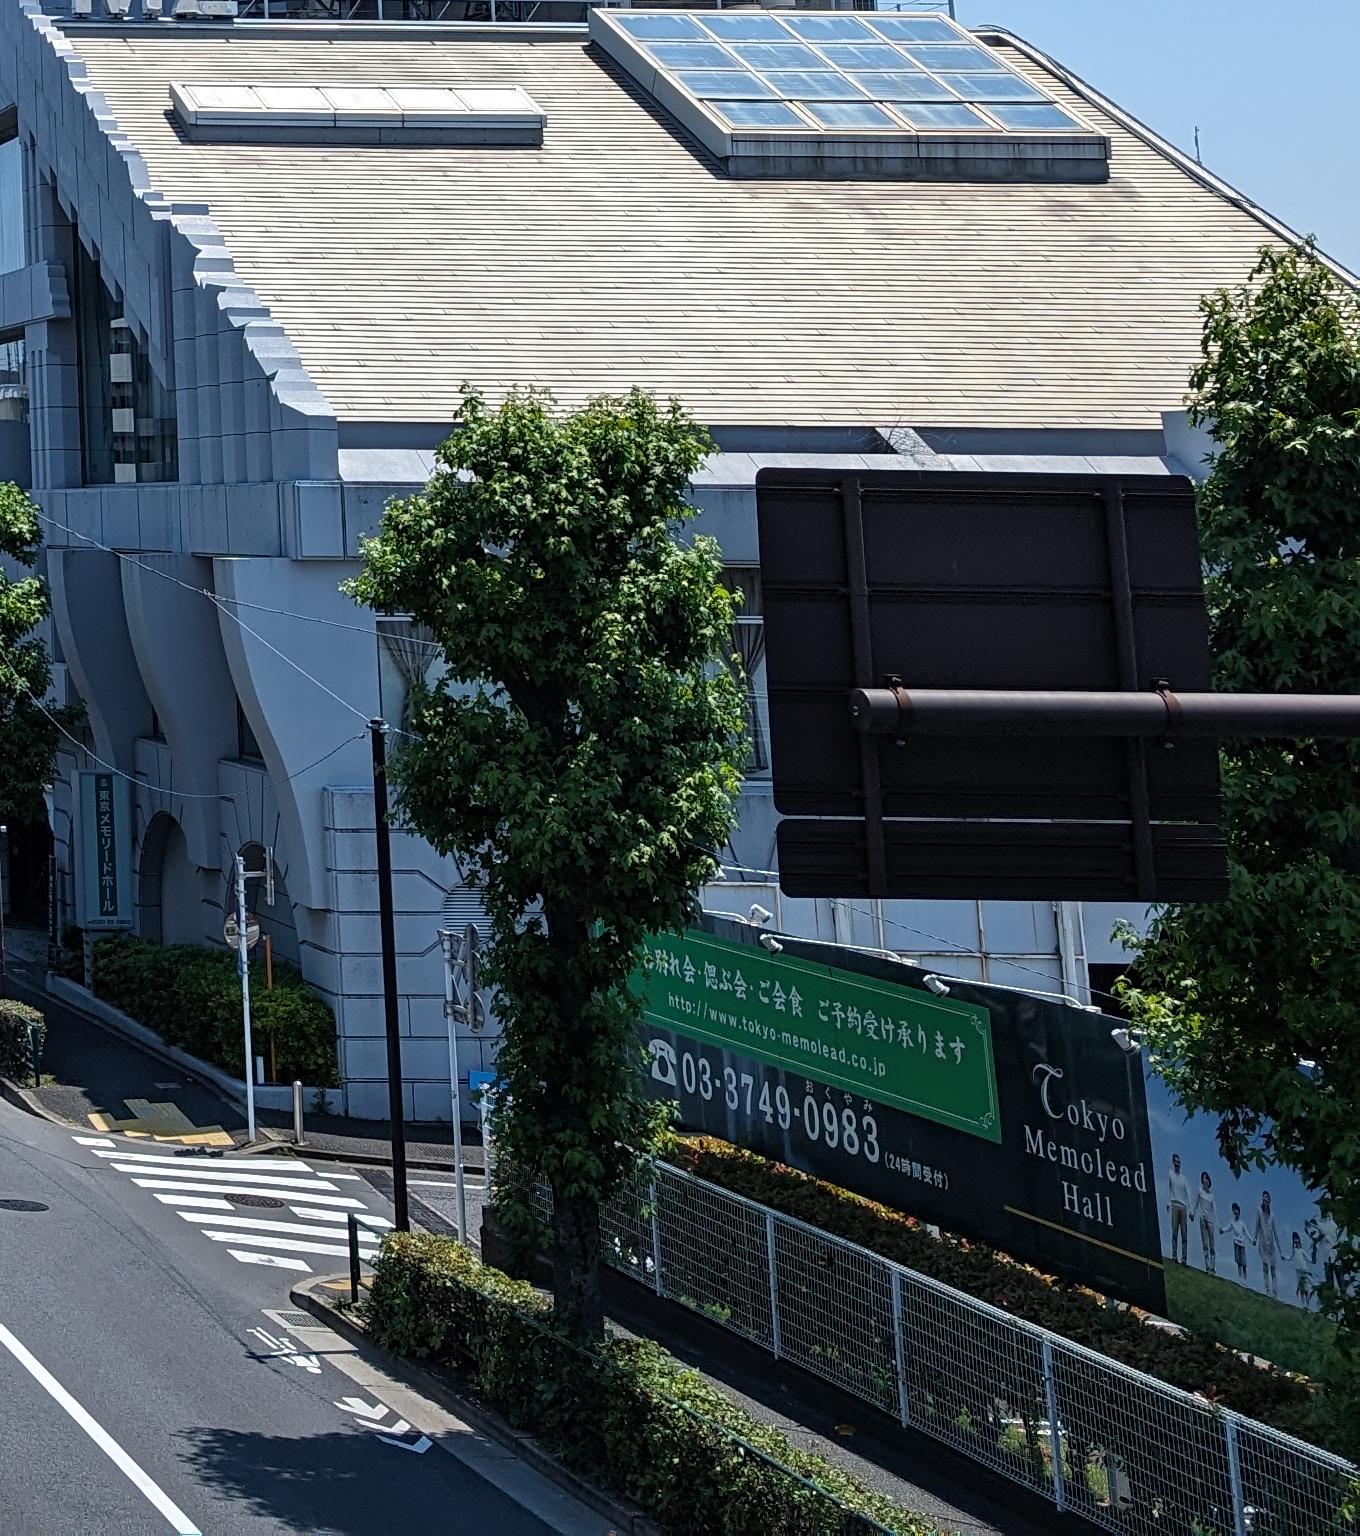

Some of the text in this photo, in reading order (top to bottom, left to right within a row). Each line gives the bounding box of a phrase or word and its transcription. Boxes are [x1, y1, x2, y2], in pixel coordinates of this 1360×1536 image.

[98, 790, 115, 912] 東京メモリードホール
[668, 991, 887, 1077] http://www.tokyo-memolead.co.jp
[818, 999, 966, 1066] ご予約受け承ります
[805, 1079, 874, 1113] おくやみ
[1033, 1063, 1125, 1142] Tokyo
[884, 1152, 949, 1191] (24時間受付)
[1023, 1124, 1147, 1193] Memolead
[1061, 1180, 1114, 1227] Hall
